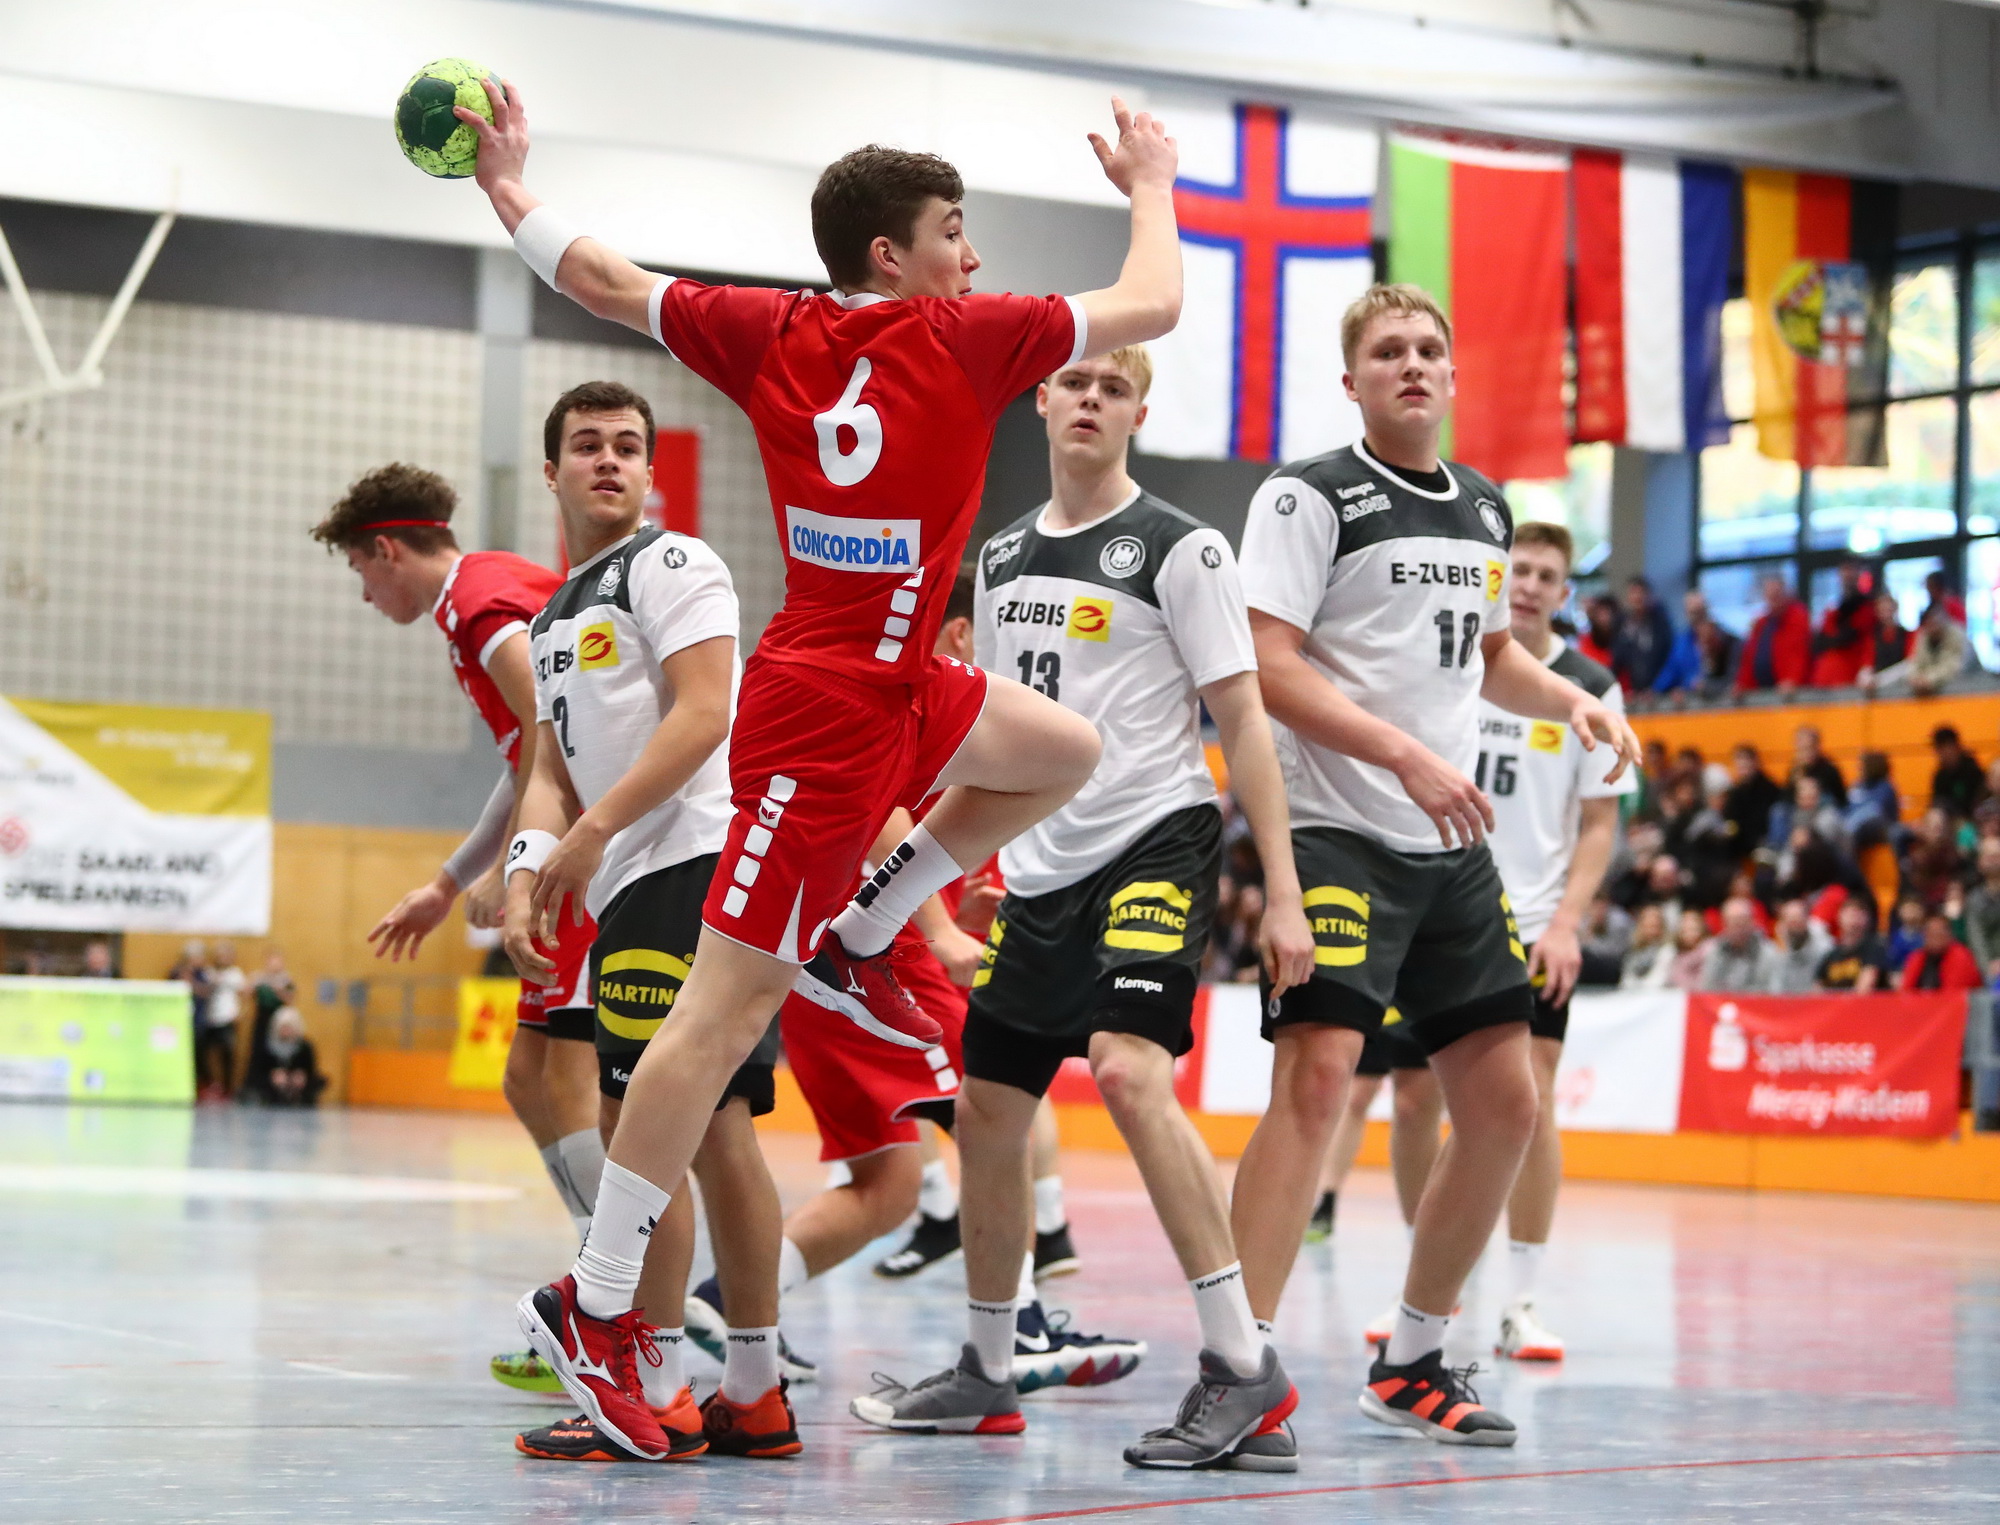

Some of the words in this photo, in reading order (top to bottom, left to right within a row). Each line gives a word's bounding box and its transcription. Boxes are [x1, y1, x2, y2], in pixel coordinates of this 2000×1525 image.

[814, 357, 883, 486] 6
[792, 524, 910, 566] CONCORDIA
[1391, 562, 1482, 588] E-ZUBIS
[1433, 609, 1480, 669] 18
[1017, 650, 1061, 702] 13
[552, 695, 576, 758] 2
[1109, 904, 1187, 931] HARTING
[1309, 917, 1367, 940] ARTING
[1114, 976, 1164, 993] Kempa
[727, 1334, 766, 1345] empa
[550, 1430, 594, 1439] Kempa
